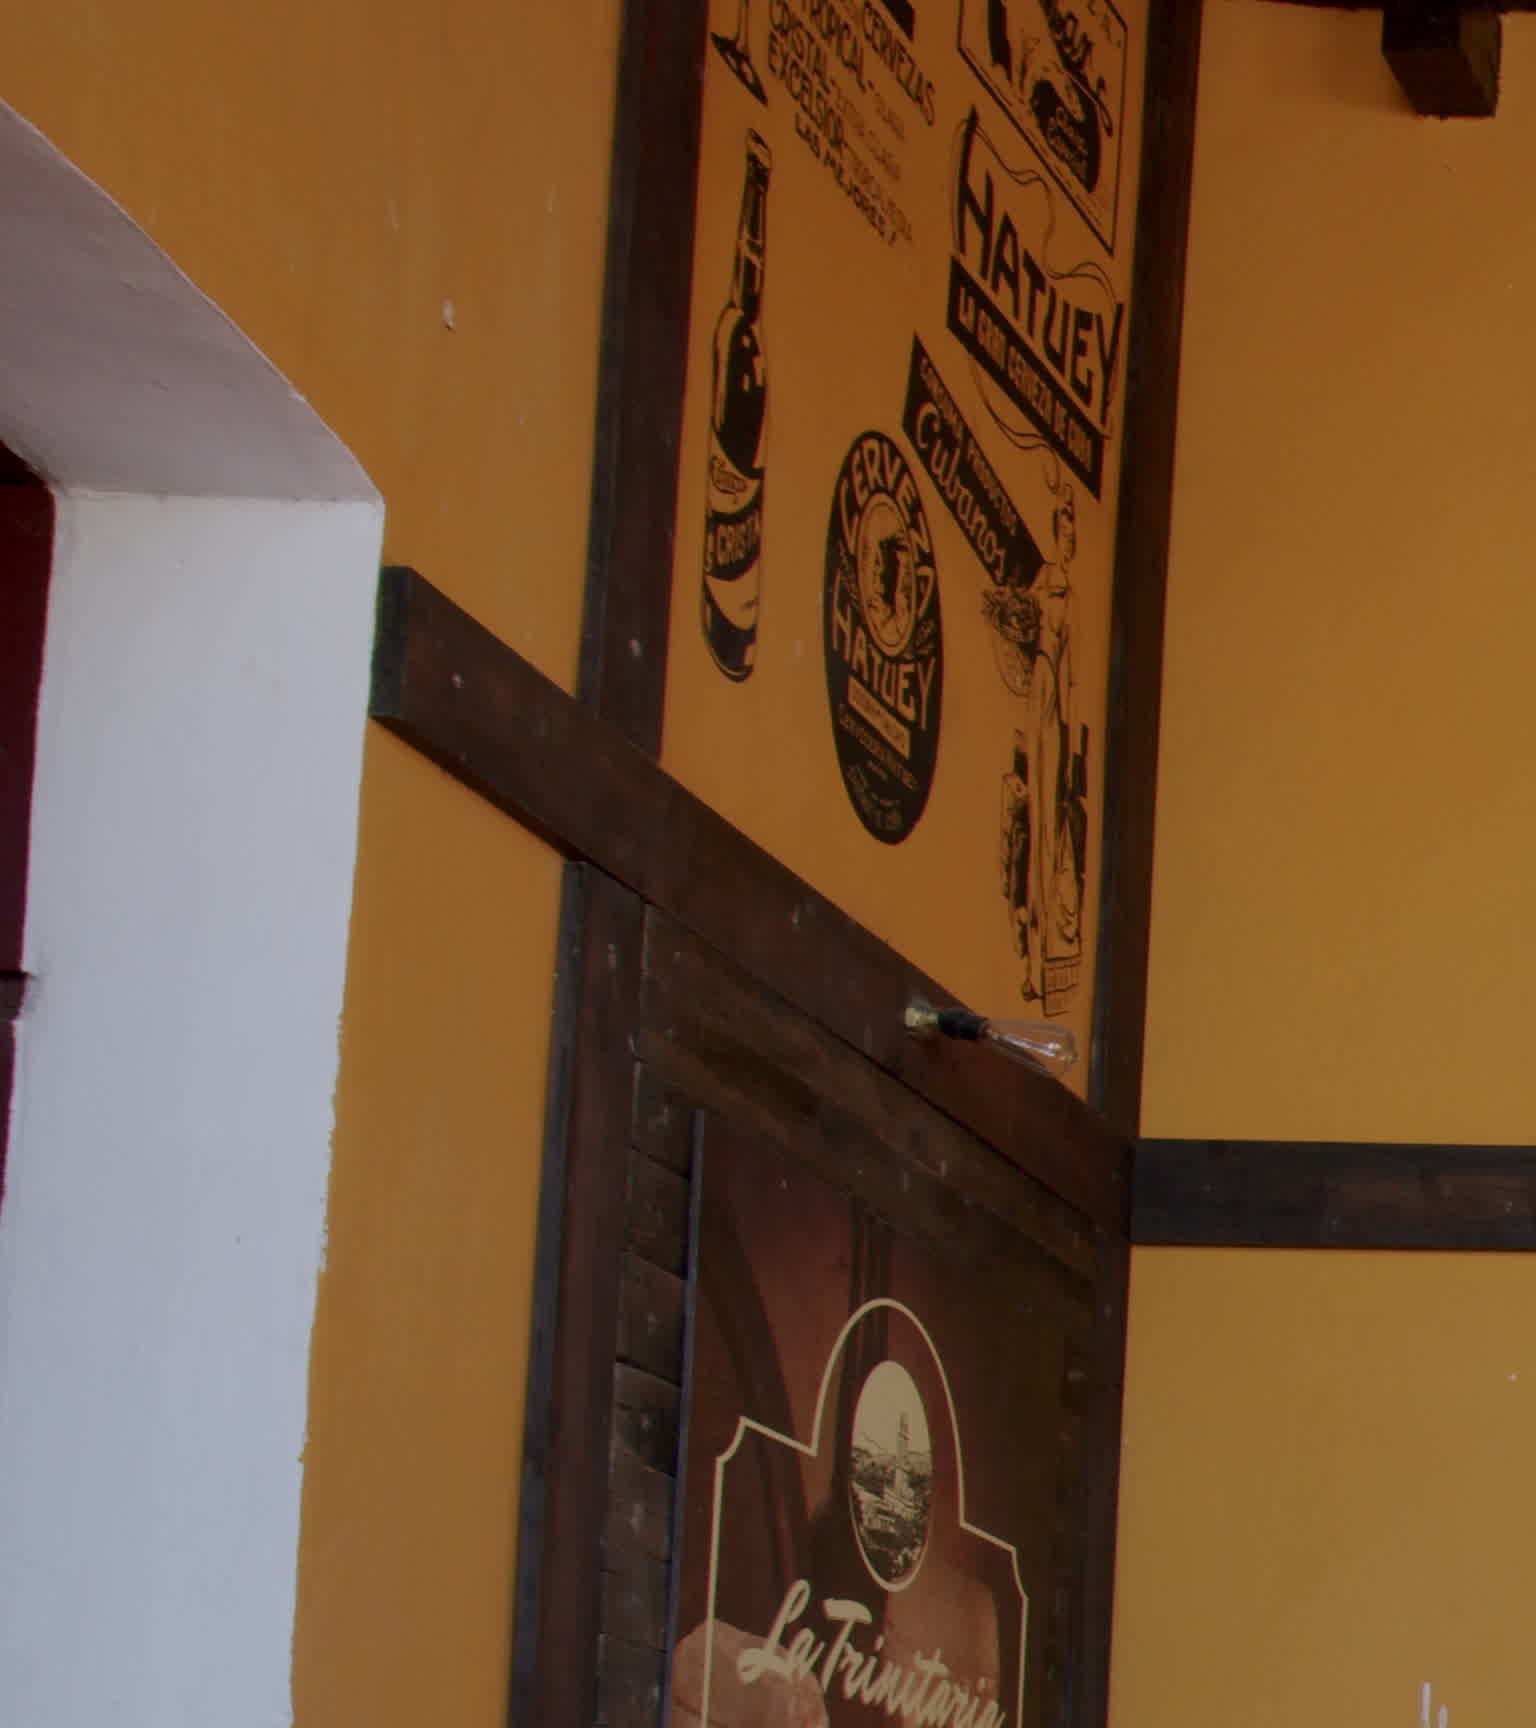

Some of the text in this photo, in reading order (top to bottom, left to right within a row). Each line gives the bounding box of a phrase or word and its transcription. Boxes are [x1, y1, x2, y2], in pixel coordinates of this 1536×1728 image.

[956, 105, 1123, 437] HATUEY
[838, 437, 936, 617] CERVEZA
[832, 567, 936, 731] HATUEY
[737, 1577, 825, 1685] La
